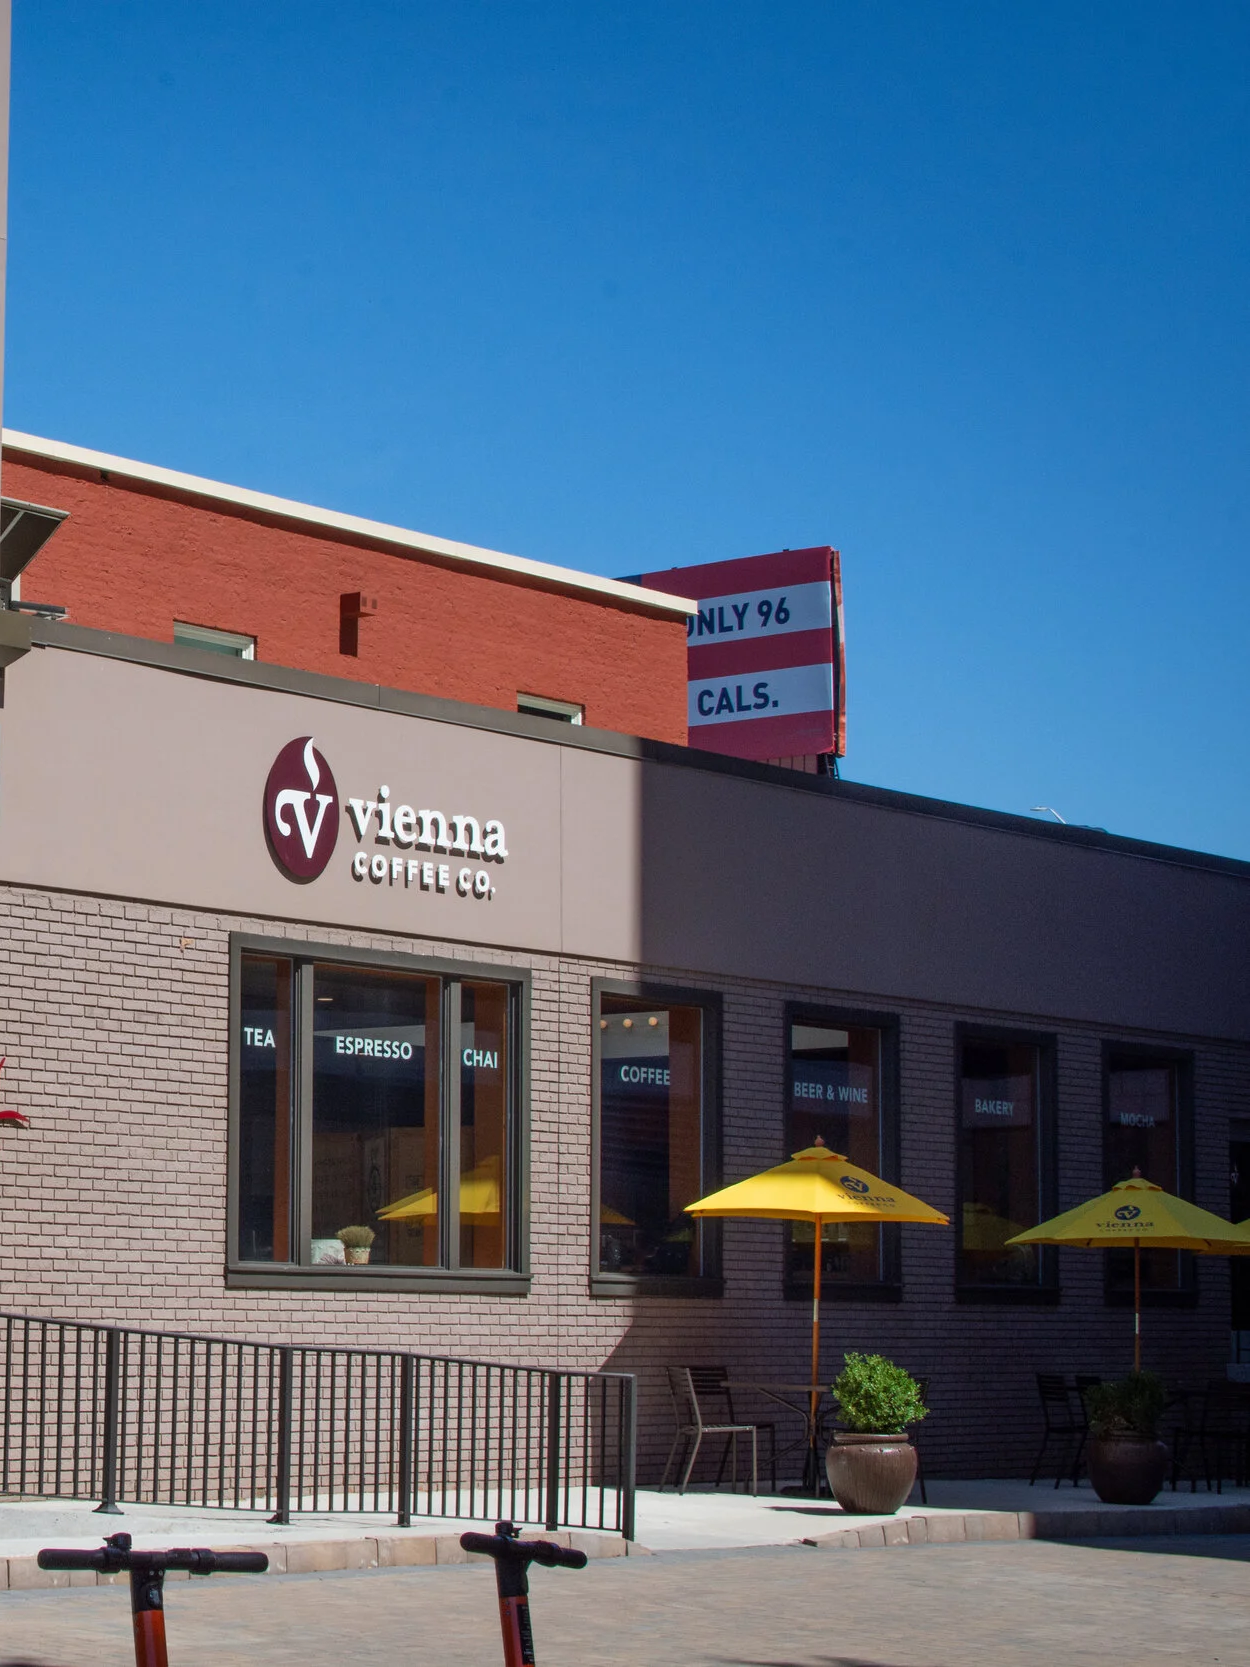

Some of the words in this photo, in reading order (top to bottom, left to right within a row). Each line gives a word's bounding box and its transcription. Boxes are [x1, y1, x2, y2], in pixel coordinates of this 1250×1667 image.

[757, 597, 790, 627] 96
[697, 682, 779, 716] CALS.
[348, 784, 508, 857] vienna
[354, 851, 450, 887] COFFEE
[458, 867, 496, 894] CO.
[243, 1027, 276, 1048] TEA
[335, 1035, 413, 1060] ESPRESSO
[463, 1049, 498, 1069] CHAI
[620, 1065, 671, 1086] COFFEE
[794, 1081, 823, 1100] BEER
[827, 1084, 835, 1100] &
[838, 1085, 868, 1104] WINE
[975, 1098, 1015, 1117] BAKERY
[1120, 1111, 1156, 1128] MOCHA
[837, 1192, 896, 1203] vienna
